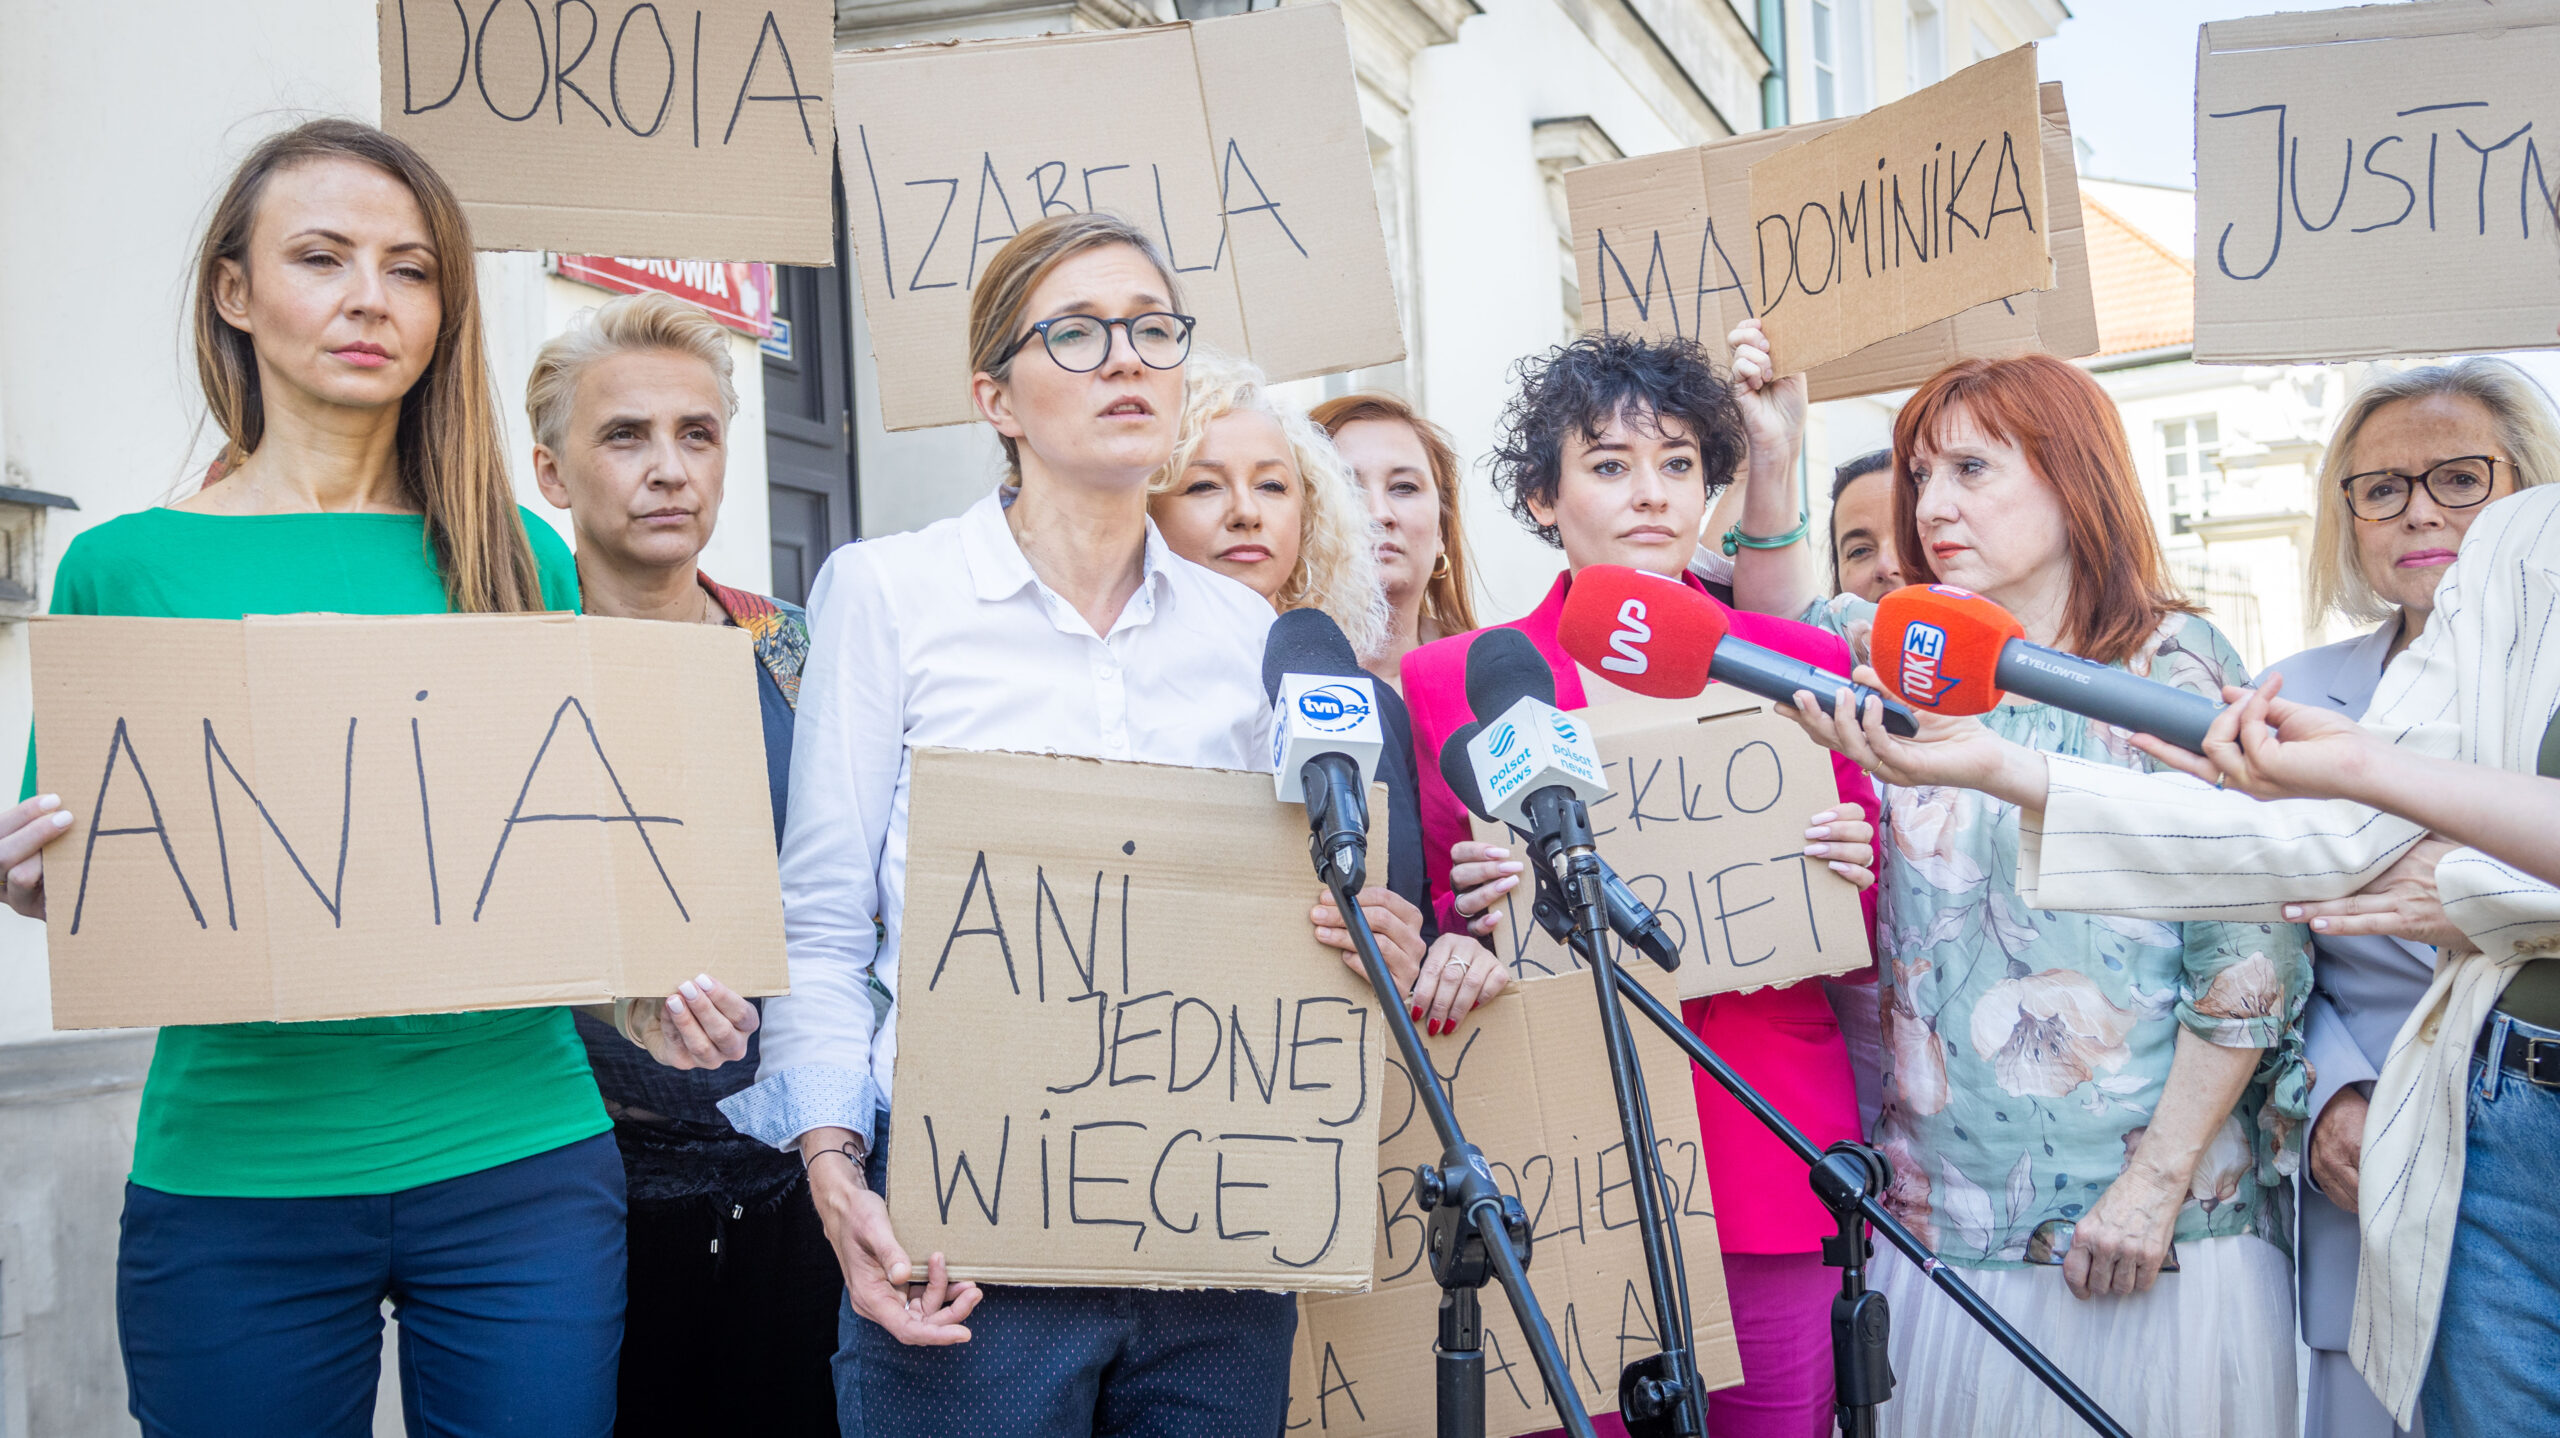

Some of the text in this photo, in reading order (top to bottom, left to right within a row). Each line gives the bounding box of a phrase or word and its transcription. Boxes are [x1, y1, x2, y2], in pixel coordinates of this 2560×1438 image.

[1903, 653, 1937, 700] TOK
[2028, 656, 2091, 685] YELLOWTEC
[1489, 747, 1532, 789] polsat
[1552, 743, 1594, 768] polsat
[1560, 758, 1594, 780] news
[1497, 765, 1532, 798] news
[1046, 990, 1368, 1127] JEDNEJ
